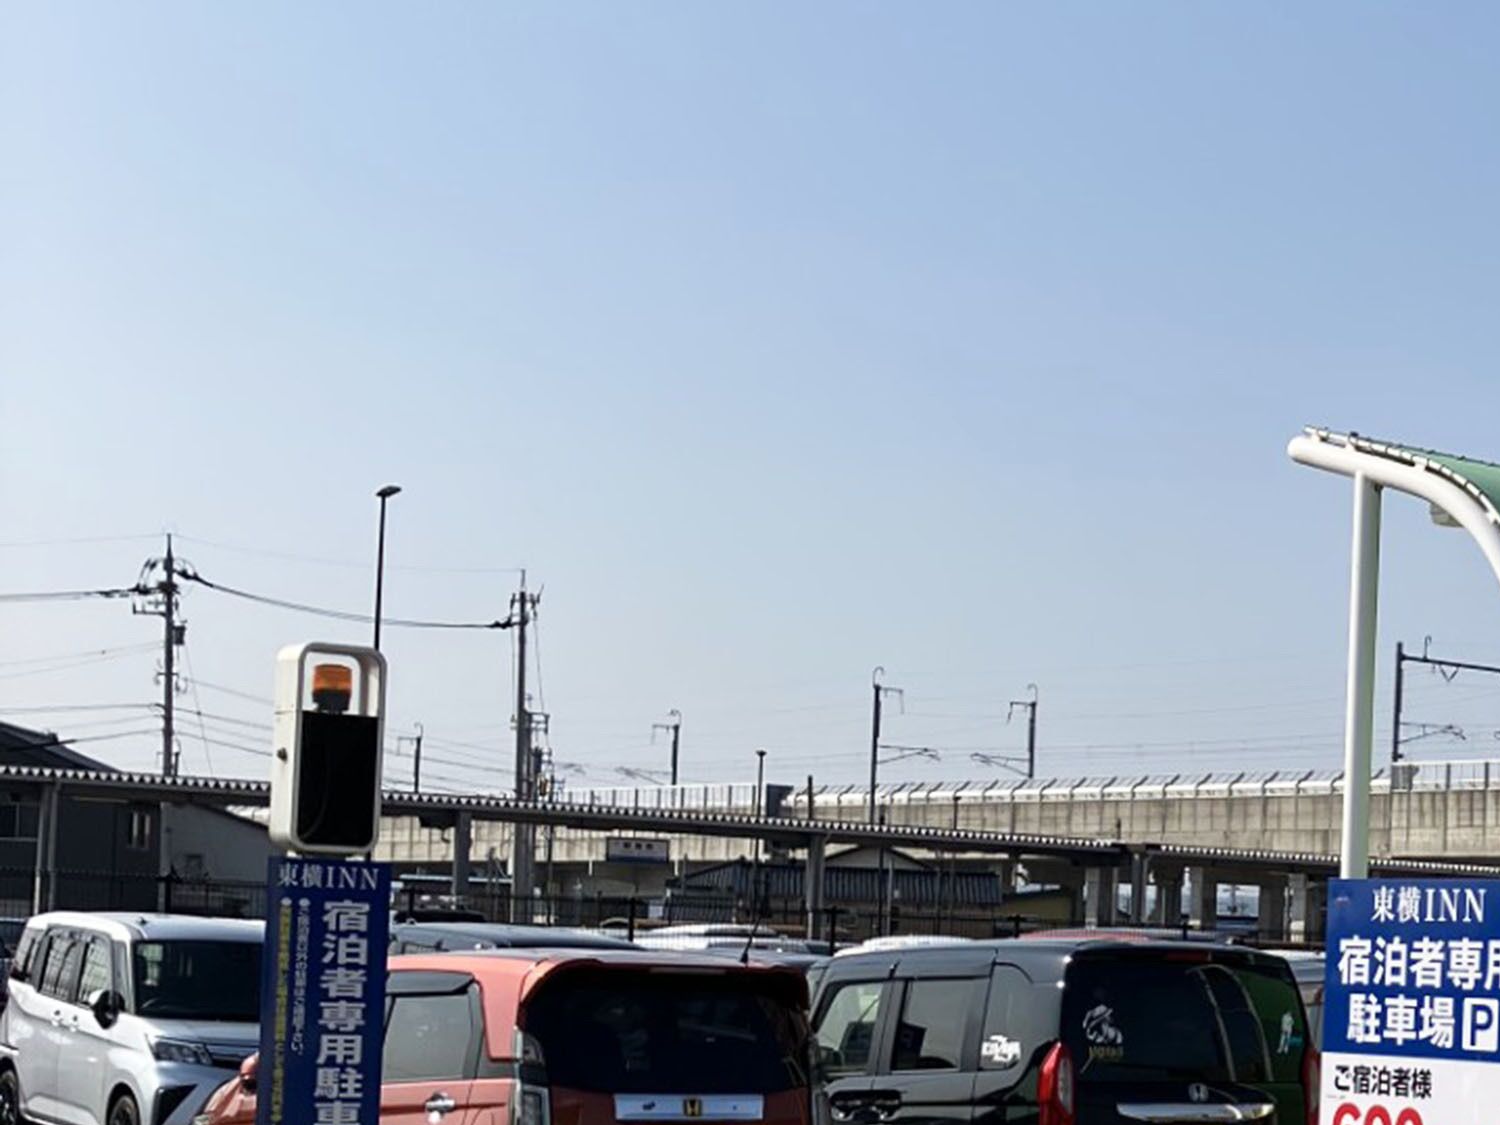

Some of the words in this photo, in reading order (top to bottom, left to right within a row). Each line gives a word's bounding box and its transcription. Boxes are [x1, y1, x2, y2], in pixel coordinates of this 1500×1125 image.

[278, 864, 380, 890] 東横INN
[1371, 885, 1486, 923] 東横INN
[1334, 1065, 1432, 1099] ご宿泊者様
